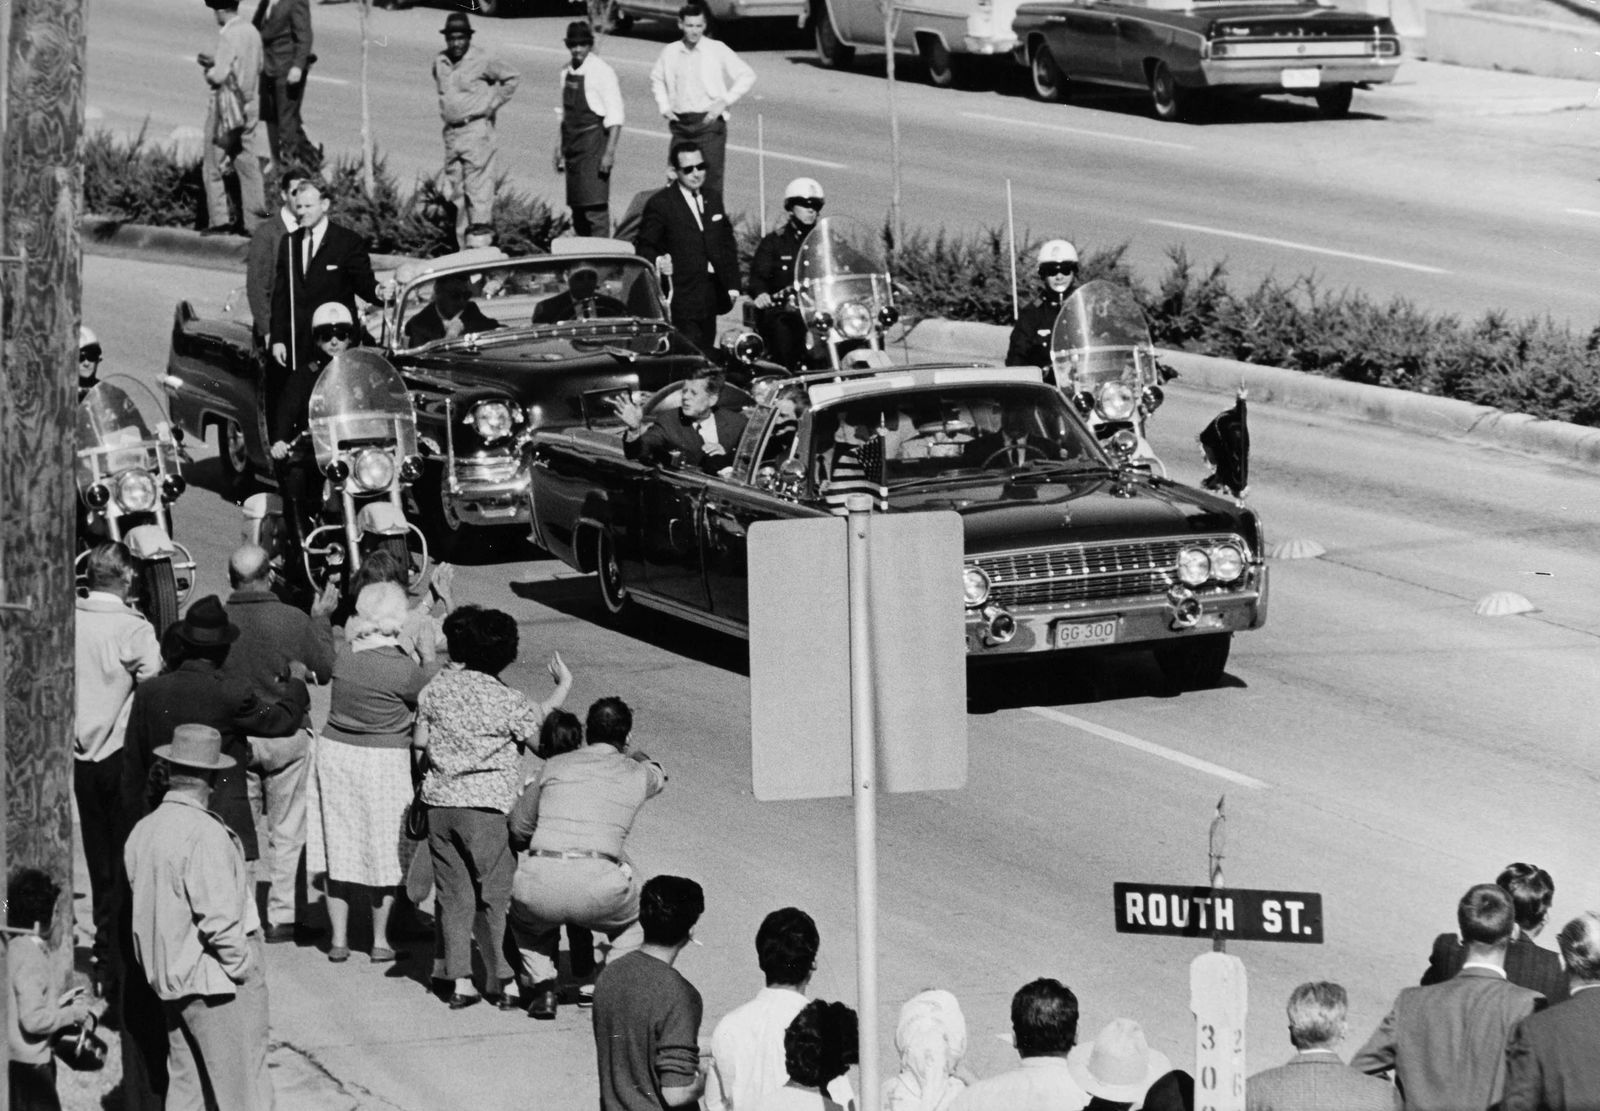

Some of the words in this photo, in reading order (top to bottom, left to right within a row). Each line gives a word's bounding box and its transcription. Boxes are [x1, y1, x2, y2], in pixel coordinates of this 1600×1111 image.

[1125, 892, 1235, 932] ROUTH
[1262, 899, 1313, 935] ST.
[1201, 1024, 1216, 1111] 30
